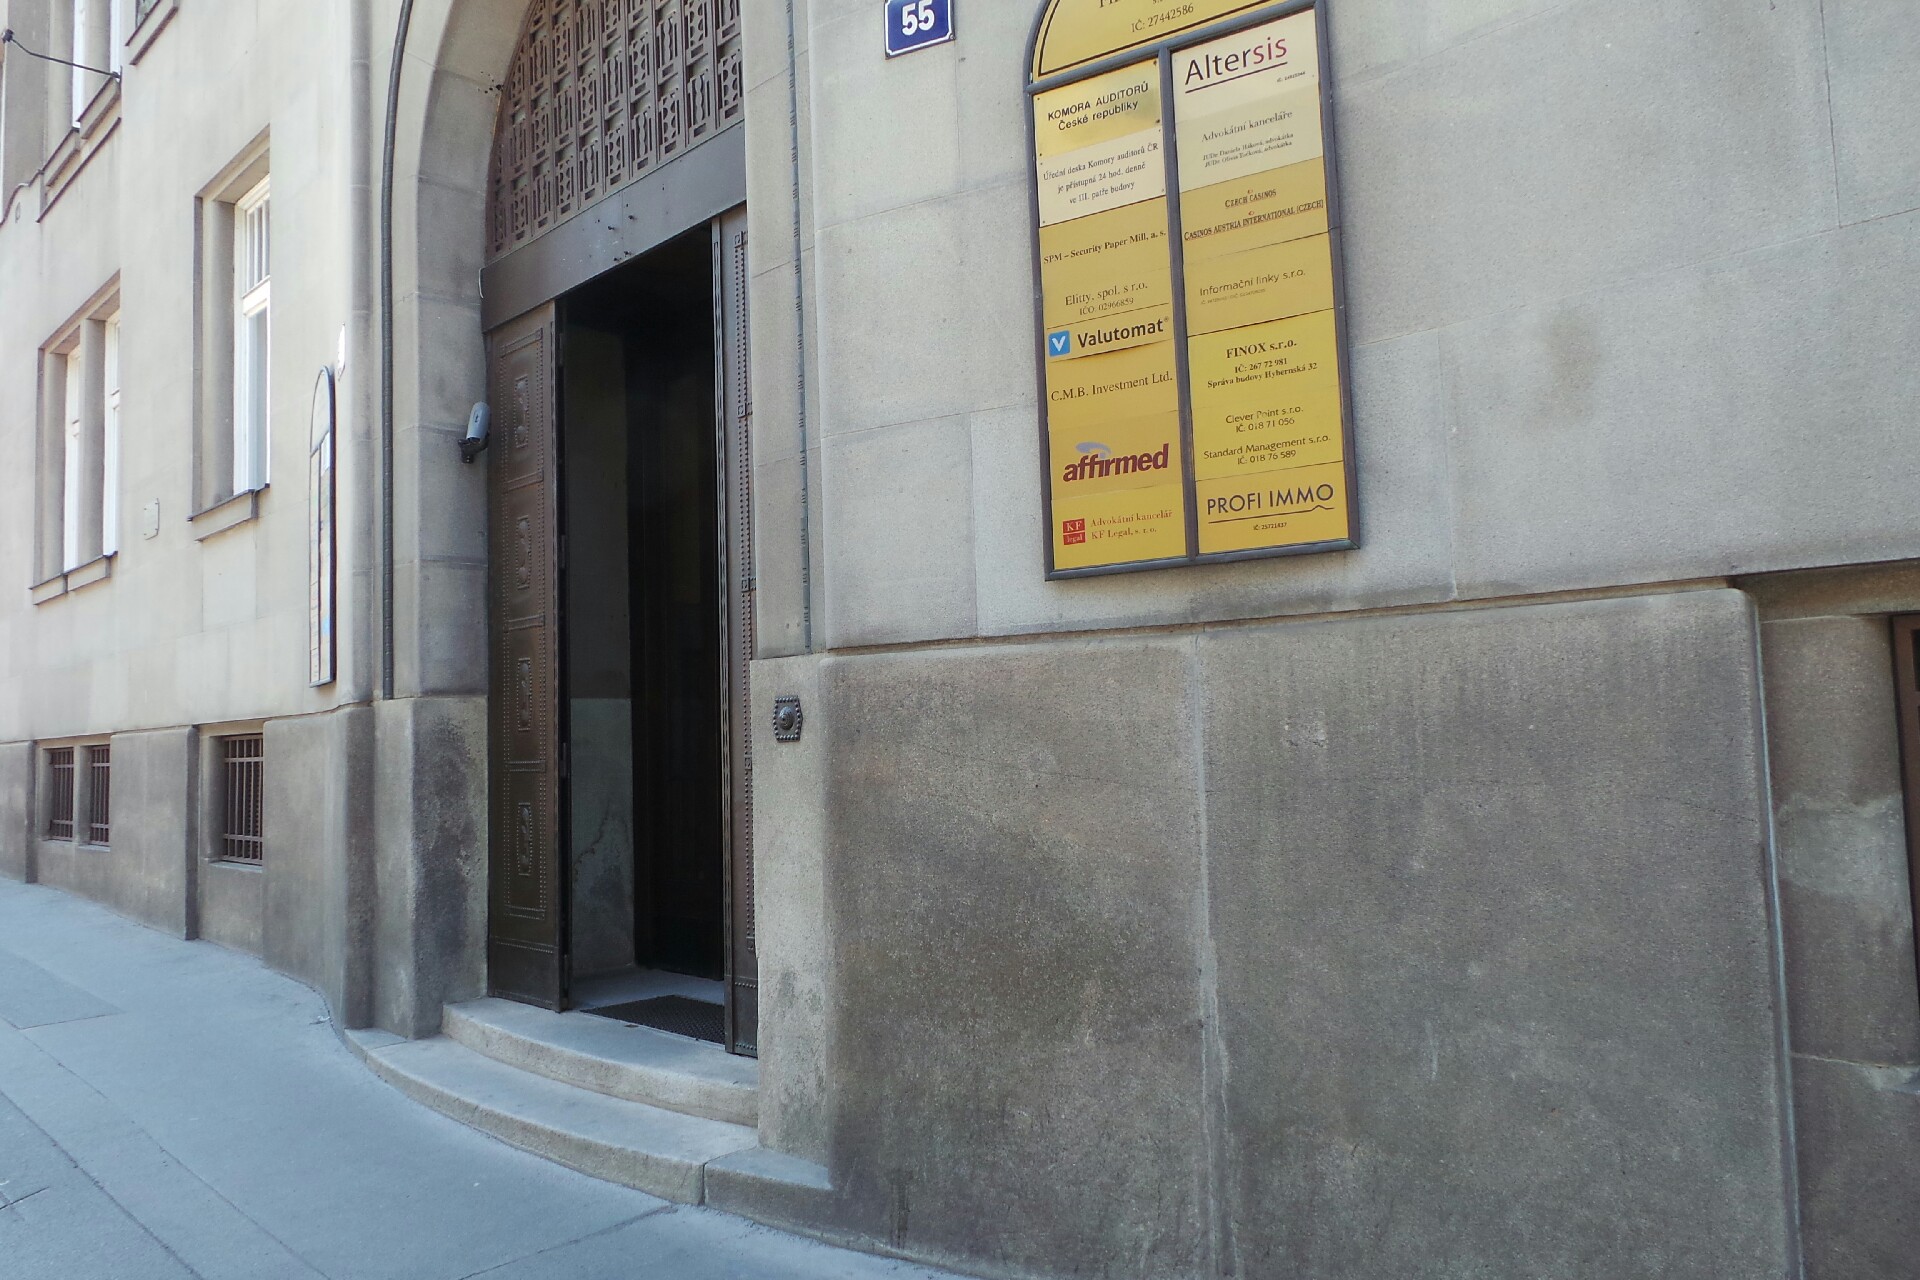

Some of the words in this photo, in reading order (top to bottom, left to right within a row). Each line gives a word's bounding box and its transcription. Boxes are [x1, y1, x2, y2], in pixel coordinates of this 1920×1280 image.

[902, 0, 935, 36] 55
[1131, 19, 1145, 32] IČ:
[1148, 3, 1194, 27] 27442586
[1185, 37, 1287, 85] Altersis
[1048, 101, 1091, 121] KOMORA
[1096, 81, 1149, 106] AUDITORŮ
[1058, 115, 1088, 131] České
[1092, 101, 1138, 120] republiky
[1202, 121, 1247, 142] Advokátní
[1249, 110, 1293, 129] kanceláře
[1043, 168, 1066, 180] Úřední
[1068, 164, 1086, 174] deska
[1088, 156, 1115, 169] Komory
[1117, 147, 1145, 160] auditorů
[1147, 142, 1159, 152] ČR
[1058, 185, 1064, 194] je
[1066, 176, 1097, 192] přístupná
[1099, 173, 1107, 182] 24
[1109, 168, 1124, 178] hod.
[1125, 163, 1146, 174] denně
[1079, 193, 1091, 202] III.
[1092, 188, 1109, 200] patře
[1111, 182, 1135, 195] budovy
[1225, 196, 1248, 208] CZECH
[1250, 189, 1277, 202] CASINOS
[1184, 228, 1212, 241] CASINOS
[1214, 219, 1241, 234] AUSTRIA
[1243, 206, 1296, 226] INTERNATIONAL
[1044, 252, 1063, 264] SPM
[1071, 244, 1103, 258] Security
[1105, 238, 1128, 250] Paper
[1130, 232, 1149, 244] Mill,
[1098, 285, 1121, 300] spol.
[1131, 282, 1148, 292] r.o.
[1200, 278, 1254, 296] Informační
[1257, 273, 1280, 286] linky
[1283, 268, 1306, 280] s.r.o.
[1227, 342, 1267, 358] FINOX
[1270, 340, 1297, 350] s.r.o.
[1208, 378, 1234, 389] Správa
[1236, 373, 1262, 383] budovy
[1265, 365, 1306, 379] Hybernská
[1308, 363, 1317, 371] 32
[1235, 364, 1247, 374] IČ:
[1249, 362, 1262, 371] 267
[1264, 360, 1273, 368] 72
[1275, 358, 1287, 366] 981
[1051, 387, 1089, 402] C.M.B.
[1092, 376, 1148, 395] Investment
[1152, 371, 1173, 384] Ltd.
[1226, 413, 1254, 424] Clever
[1257, 409, 1279, 419] Point
[1236, 424, 1246, 433] IČ:
[1278, 417, 1295, 426] 056
[1204, 446, 1243, 459] Standard
[1246, 438, 1306, 454] Management
[1309, 435, 1331, 444] s.r.o.
[1238, 455, 1248, 465] IČ:
[1250, 455, 1265, 463] 018
[1269, 453, 1278, 461] 76
[1281, 450, 1297, 459] 589
[1063, 443, 1169, 482] affirmed
[1207, 492, 1261, 516] PROFI
[1269, 483, 1334, 508] IMMO
[1066, 521, 1083, 532] KF
[1091, 516, 1134, 528] Advokátní
[1136, 509, 1173, 521] kancelář
[1092, 531, 1104, 540] KF
[1107, 528, 1133, 538] Legal,
